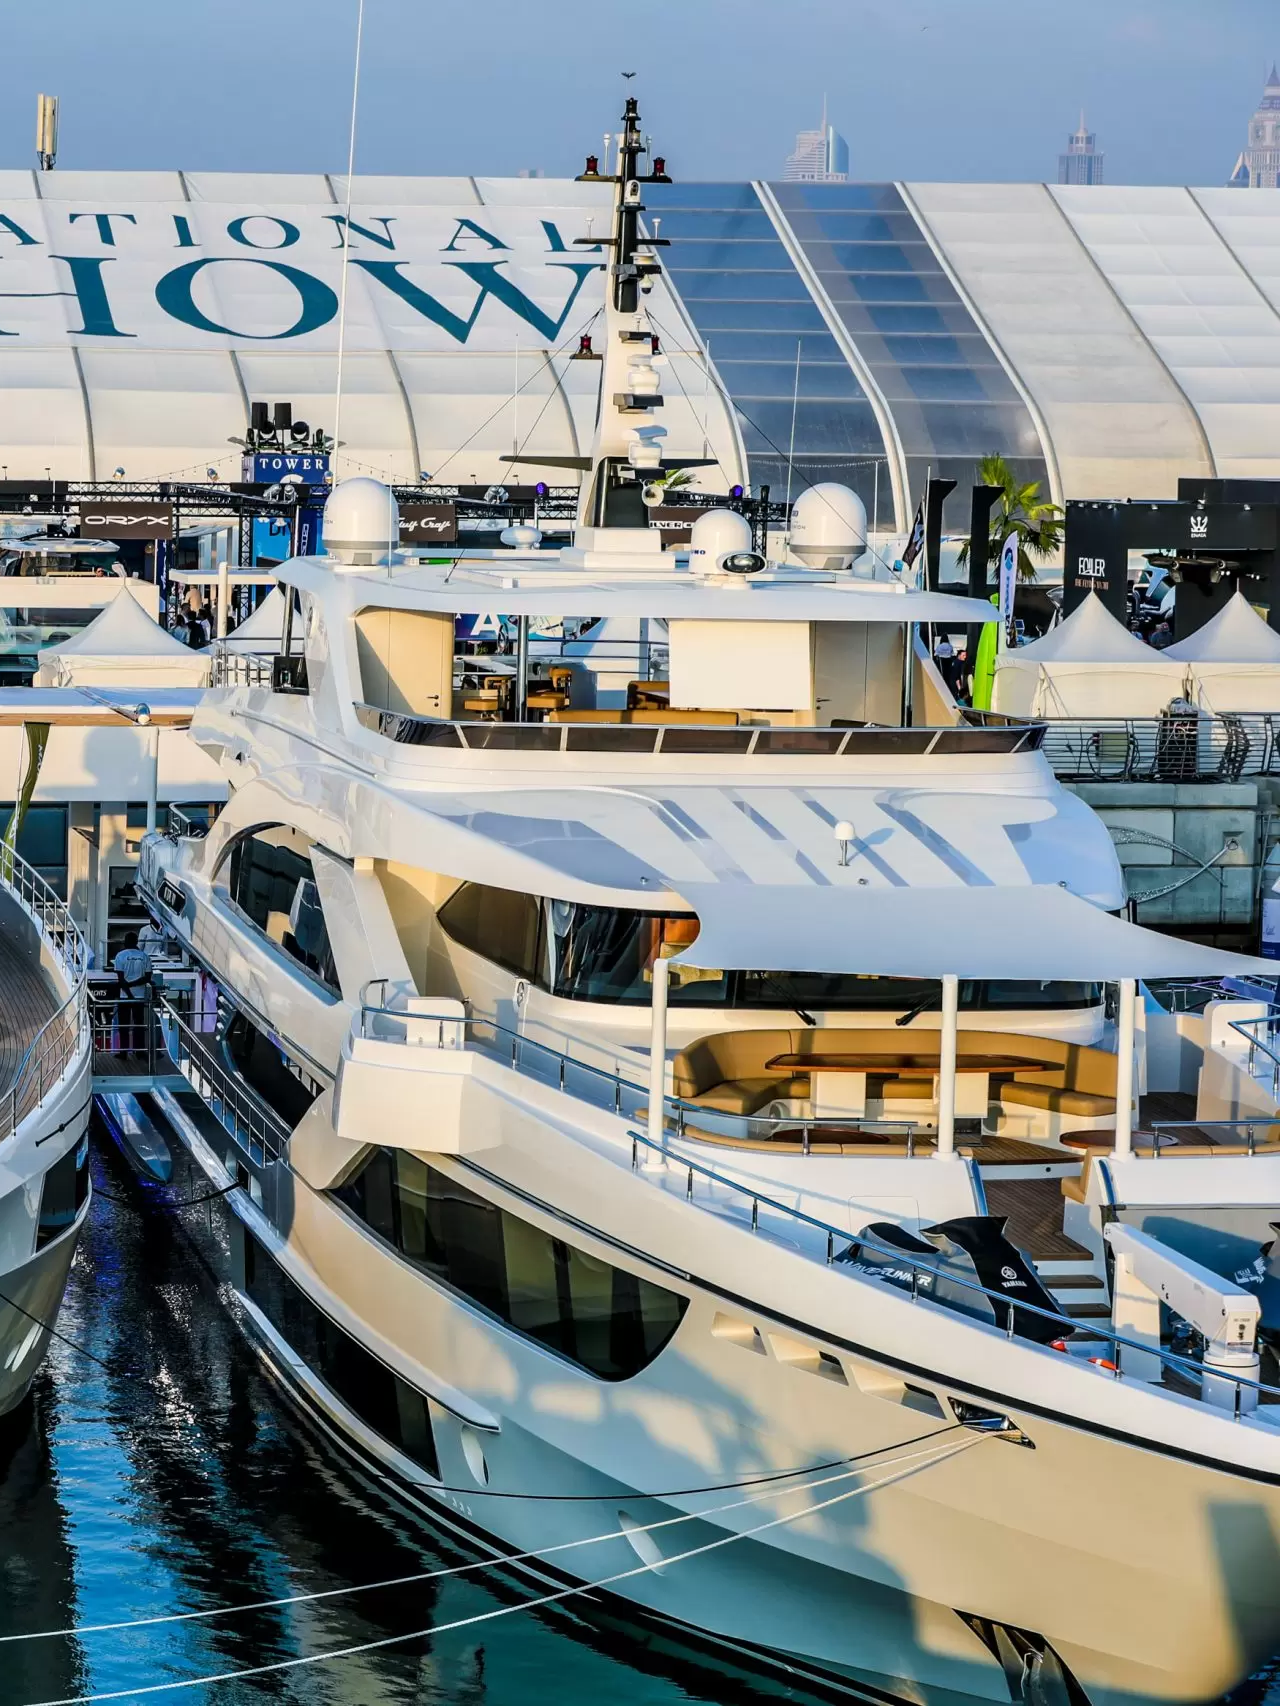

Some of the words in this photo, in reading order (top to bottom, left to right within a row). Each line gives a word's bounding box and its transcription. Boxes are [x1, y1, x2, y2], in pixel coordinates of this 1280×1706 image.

[259, 458, 324, 470] TOWER
[84, 515, 169, 526] ORYX
[420, 516, 451, 532] Craft
[649, 521, 683, 529] ILVER
[1078, 556, 1106, 578] FOILER
[1001, 1279, 1028, 1288] YAMAHA
